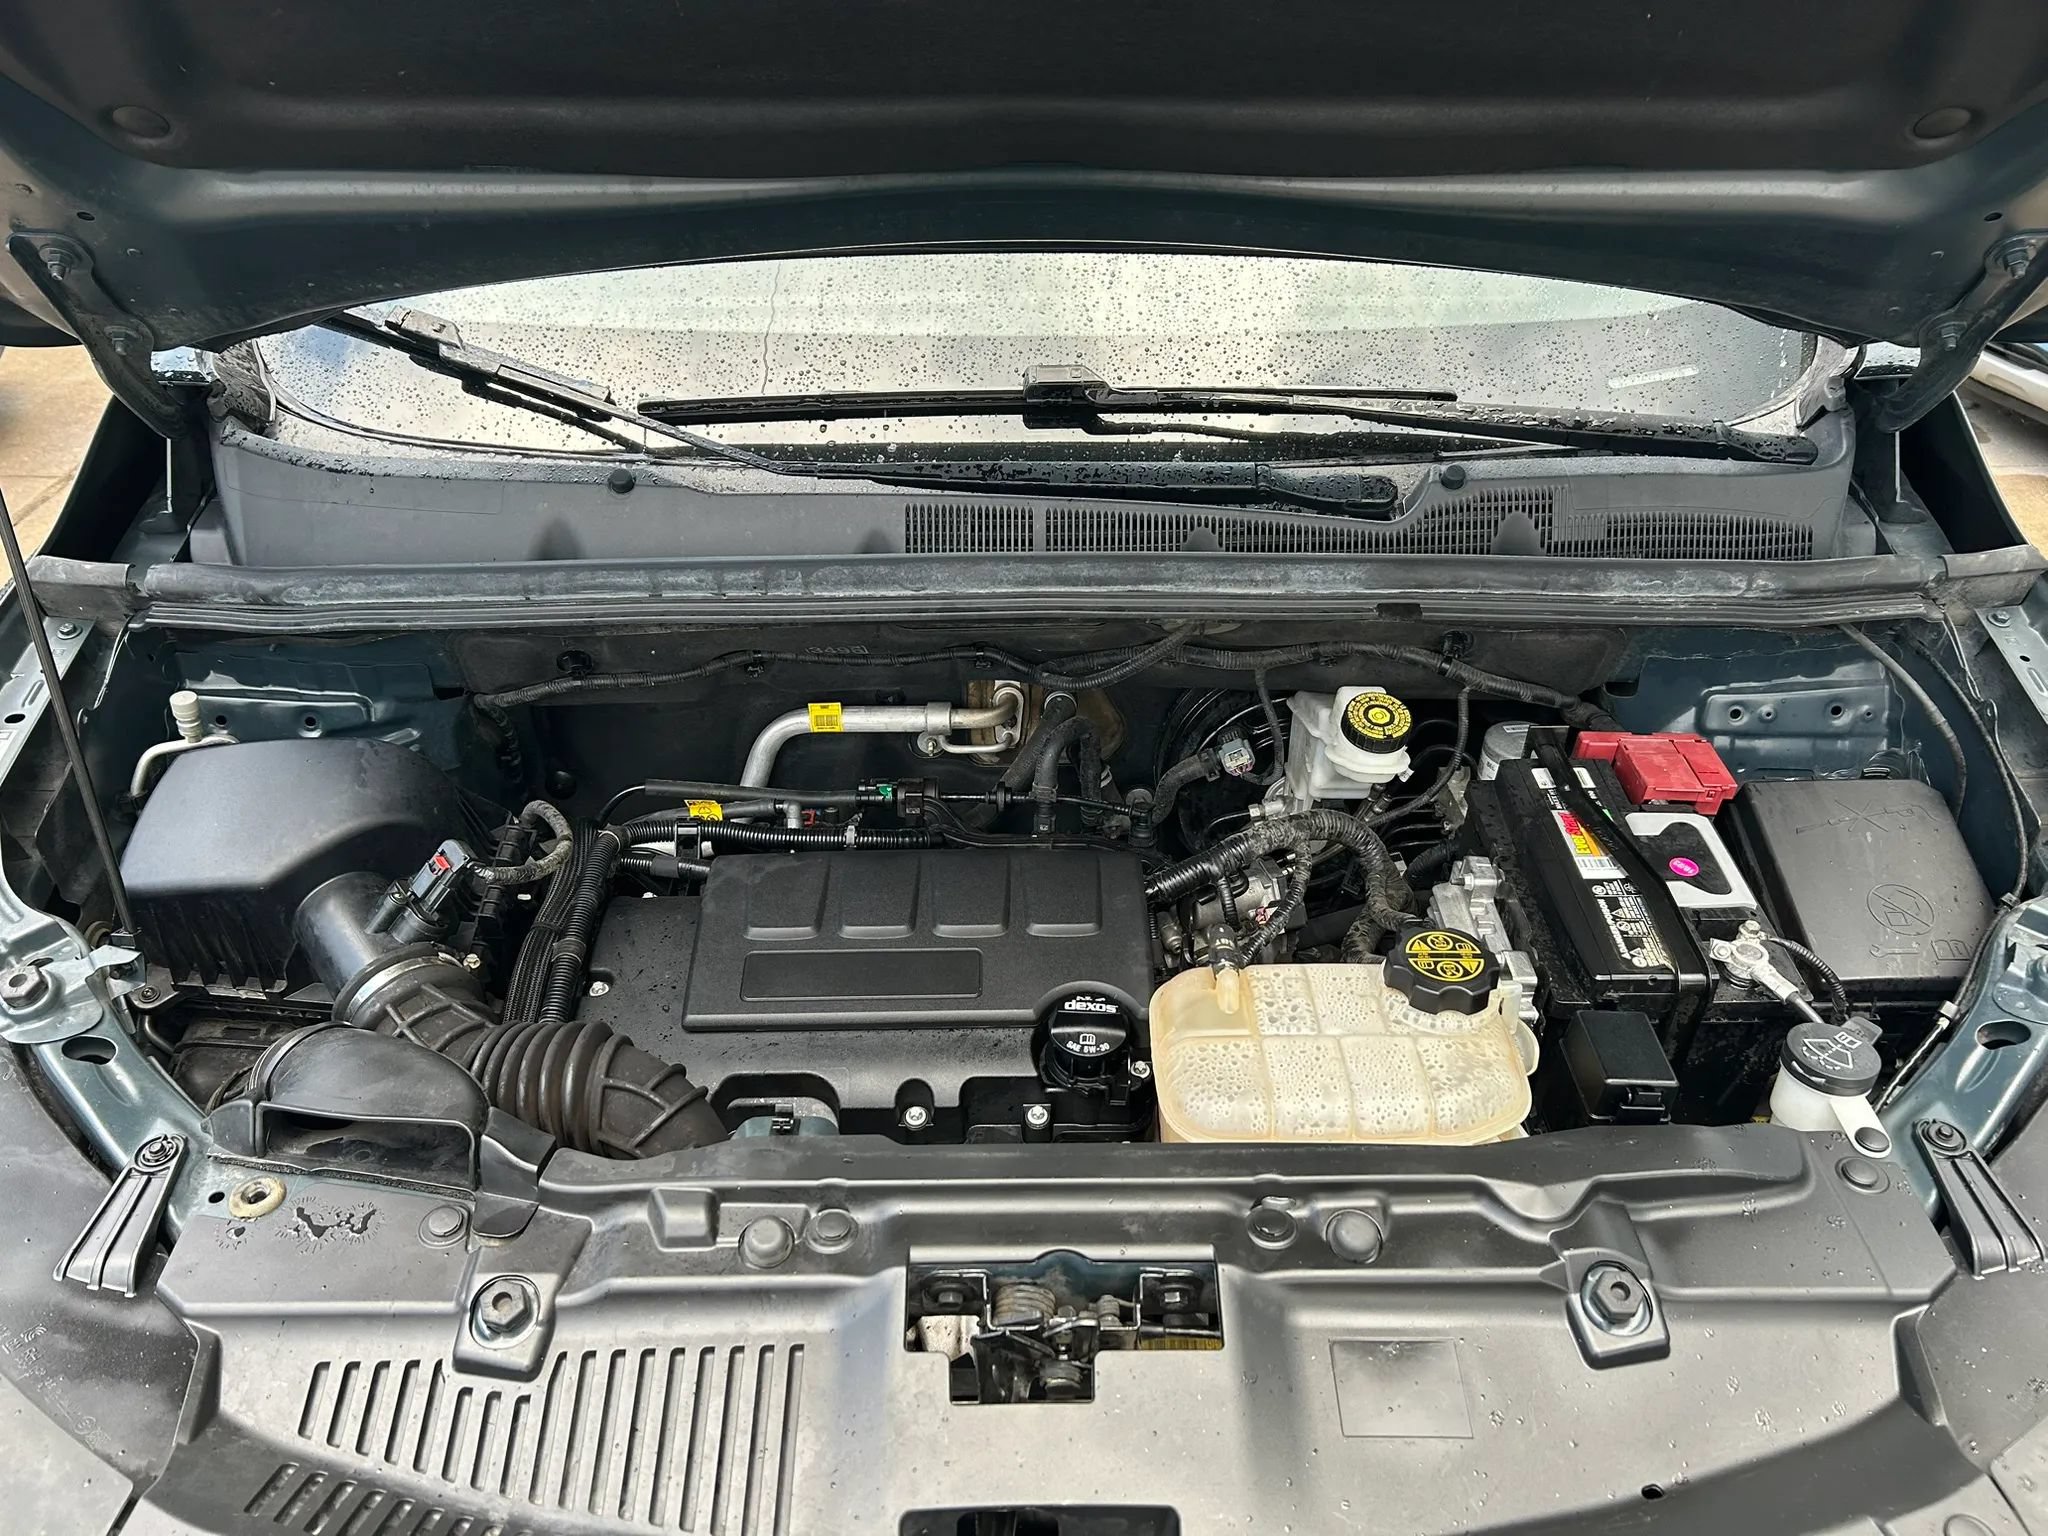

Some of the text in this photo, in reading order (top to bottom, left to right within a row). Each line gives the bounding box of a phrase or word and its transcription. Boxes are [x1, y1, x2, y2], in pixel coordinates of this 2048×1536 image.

[1064, 999, 1118, 1013] dexos
[1066, 1040, 1110, 1053] SAE 5W-30
